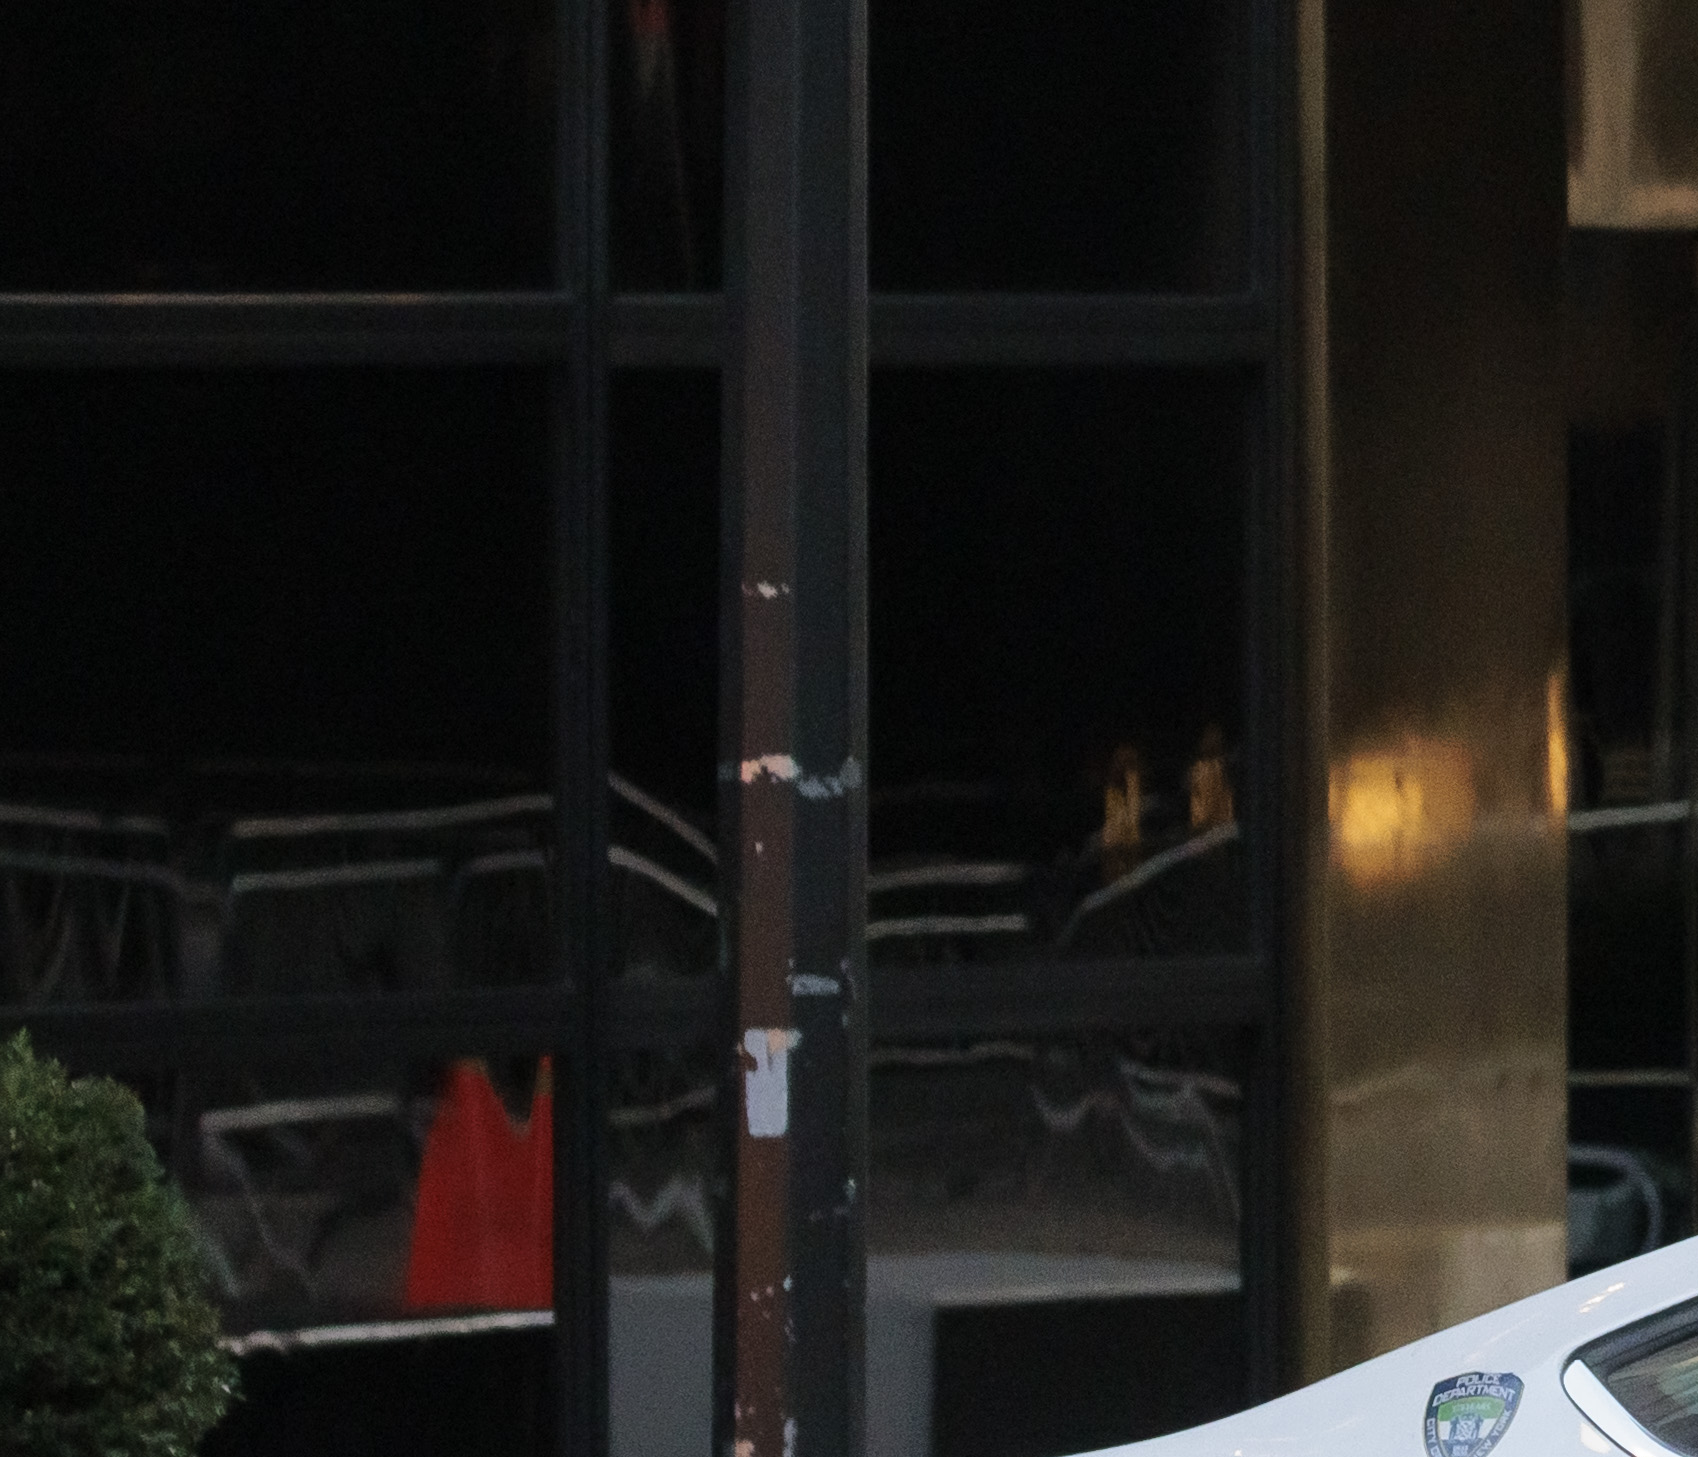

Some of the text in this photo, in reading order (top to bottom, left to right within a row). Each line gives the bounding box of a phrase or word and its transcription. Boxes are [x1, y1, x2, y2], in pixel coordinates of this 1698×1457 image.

[1456, 1373, 1502, 1387] POLICE
[1432, 1384, 1516, 1407] DEPARTMENT
[1426, 1417, 1437, 1444] CITY
[1490, 1409, 1512, 1438] YORK
